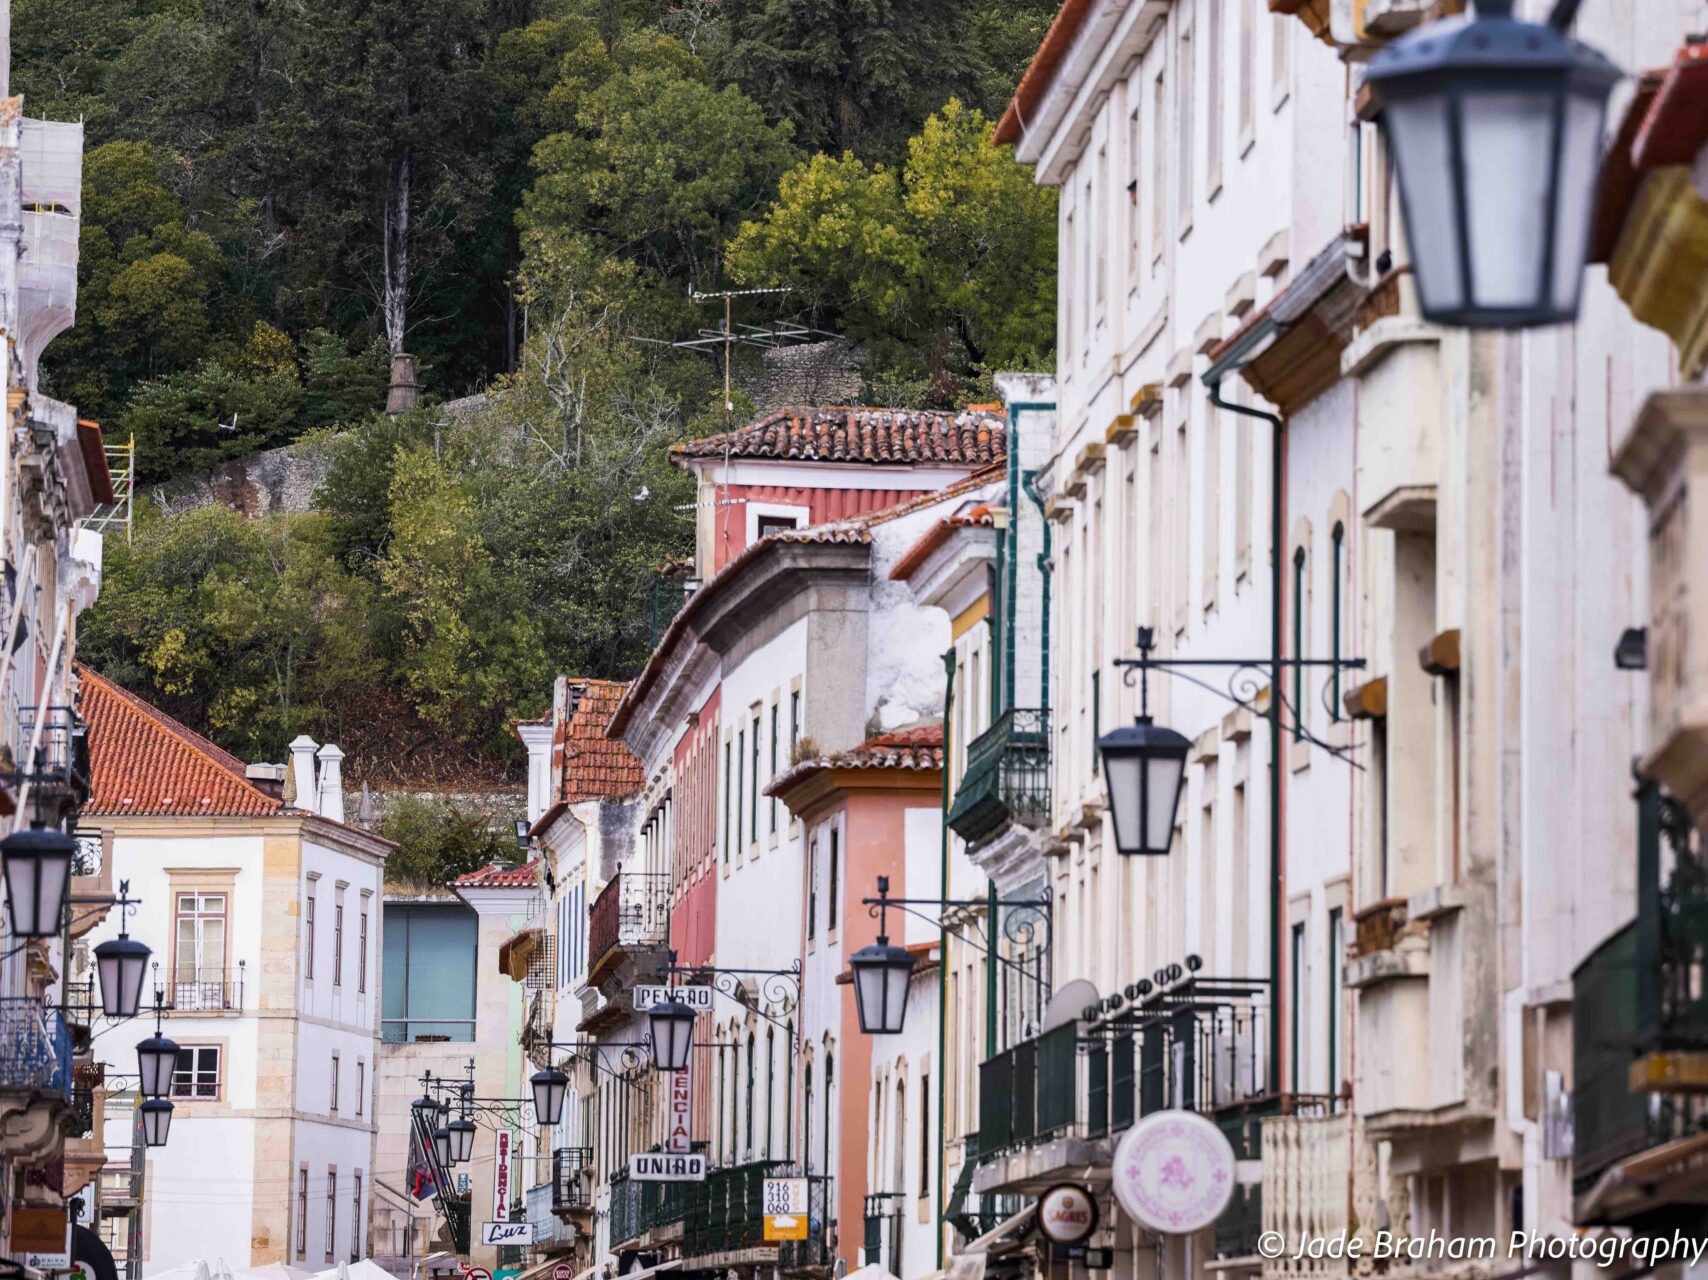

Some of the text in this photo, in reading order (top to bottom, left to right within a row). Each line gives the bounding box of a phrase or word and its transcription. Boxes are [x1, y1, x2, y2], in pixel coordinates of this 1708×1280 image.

[767, 1181, 790, 1192] 916
[767, 1191, 790, 1202] 310
[767, 1202, 790, 1214] 060
[487, 1224, 528, 1243] Luz
